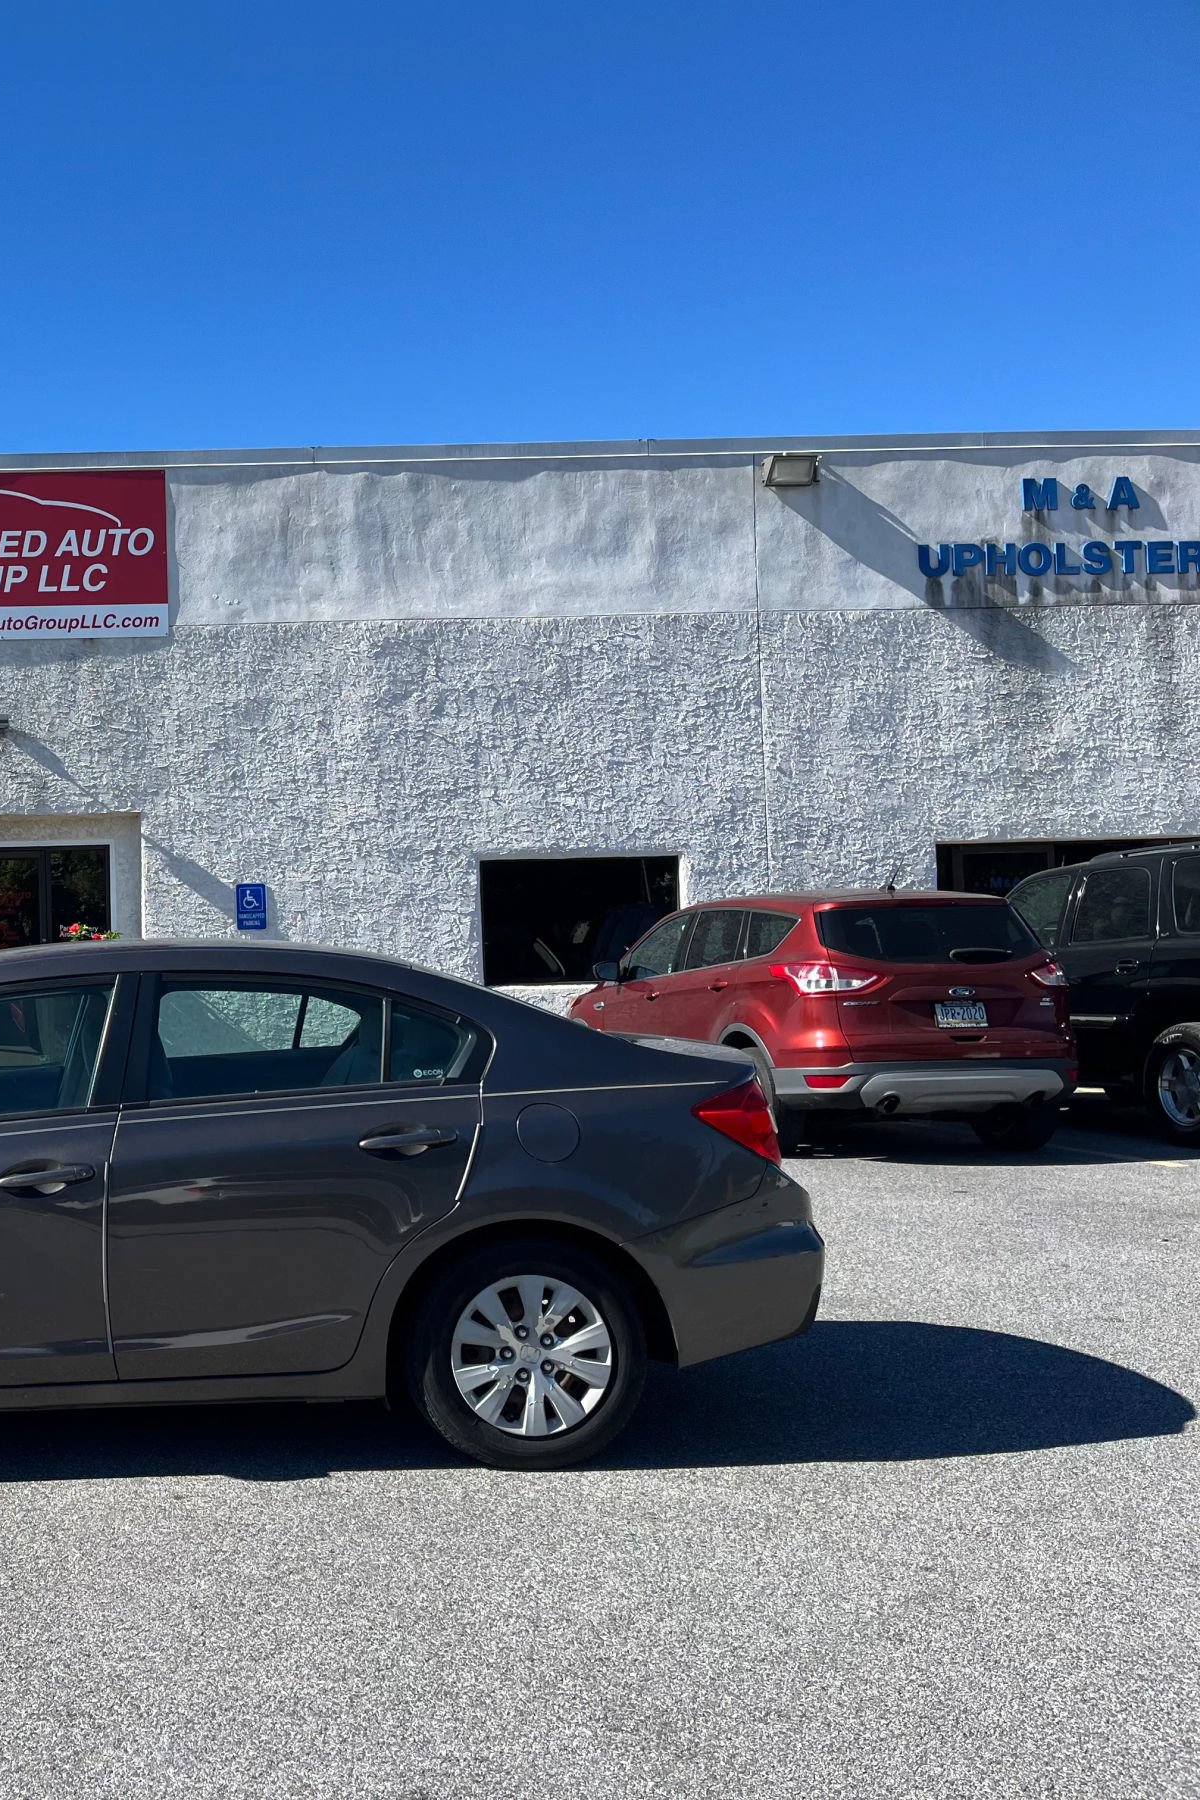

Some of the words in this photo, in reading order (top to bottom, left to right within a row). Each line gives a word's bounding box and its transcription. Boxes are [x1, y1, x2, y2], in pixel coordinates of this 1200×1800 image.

[1022, 477, 1058, 511] M
[1071, 483, 1096, 510] &
[1106, 476, 1141, 510] A
[55, 527, 154, 557] AUTO
[917, 540, 1200, 578] UPHOLSTER
[37, 563, 108, 593] LLC
